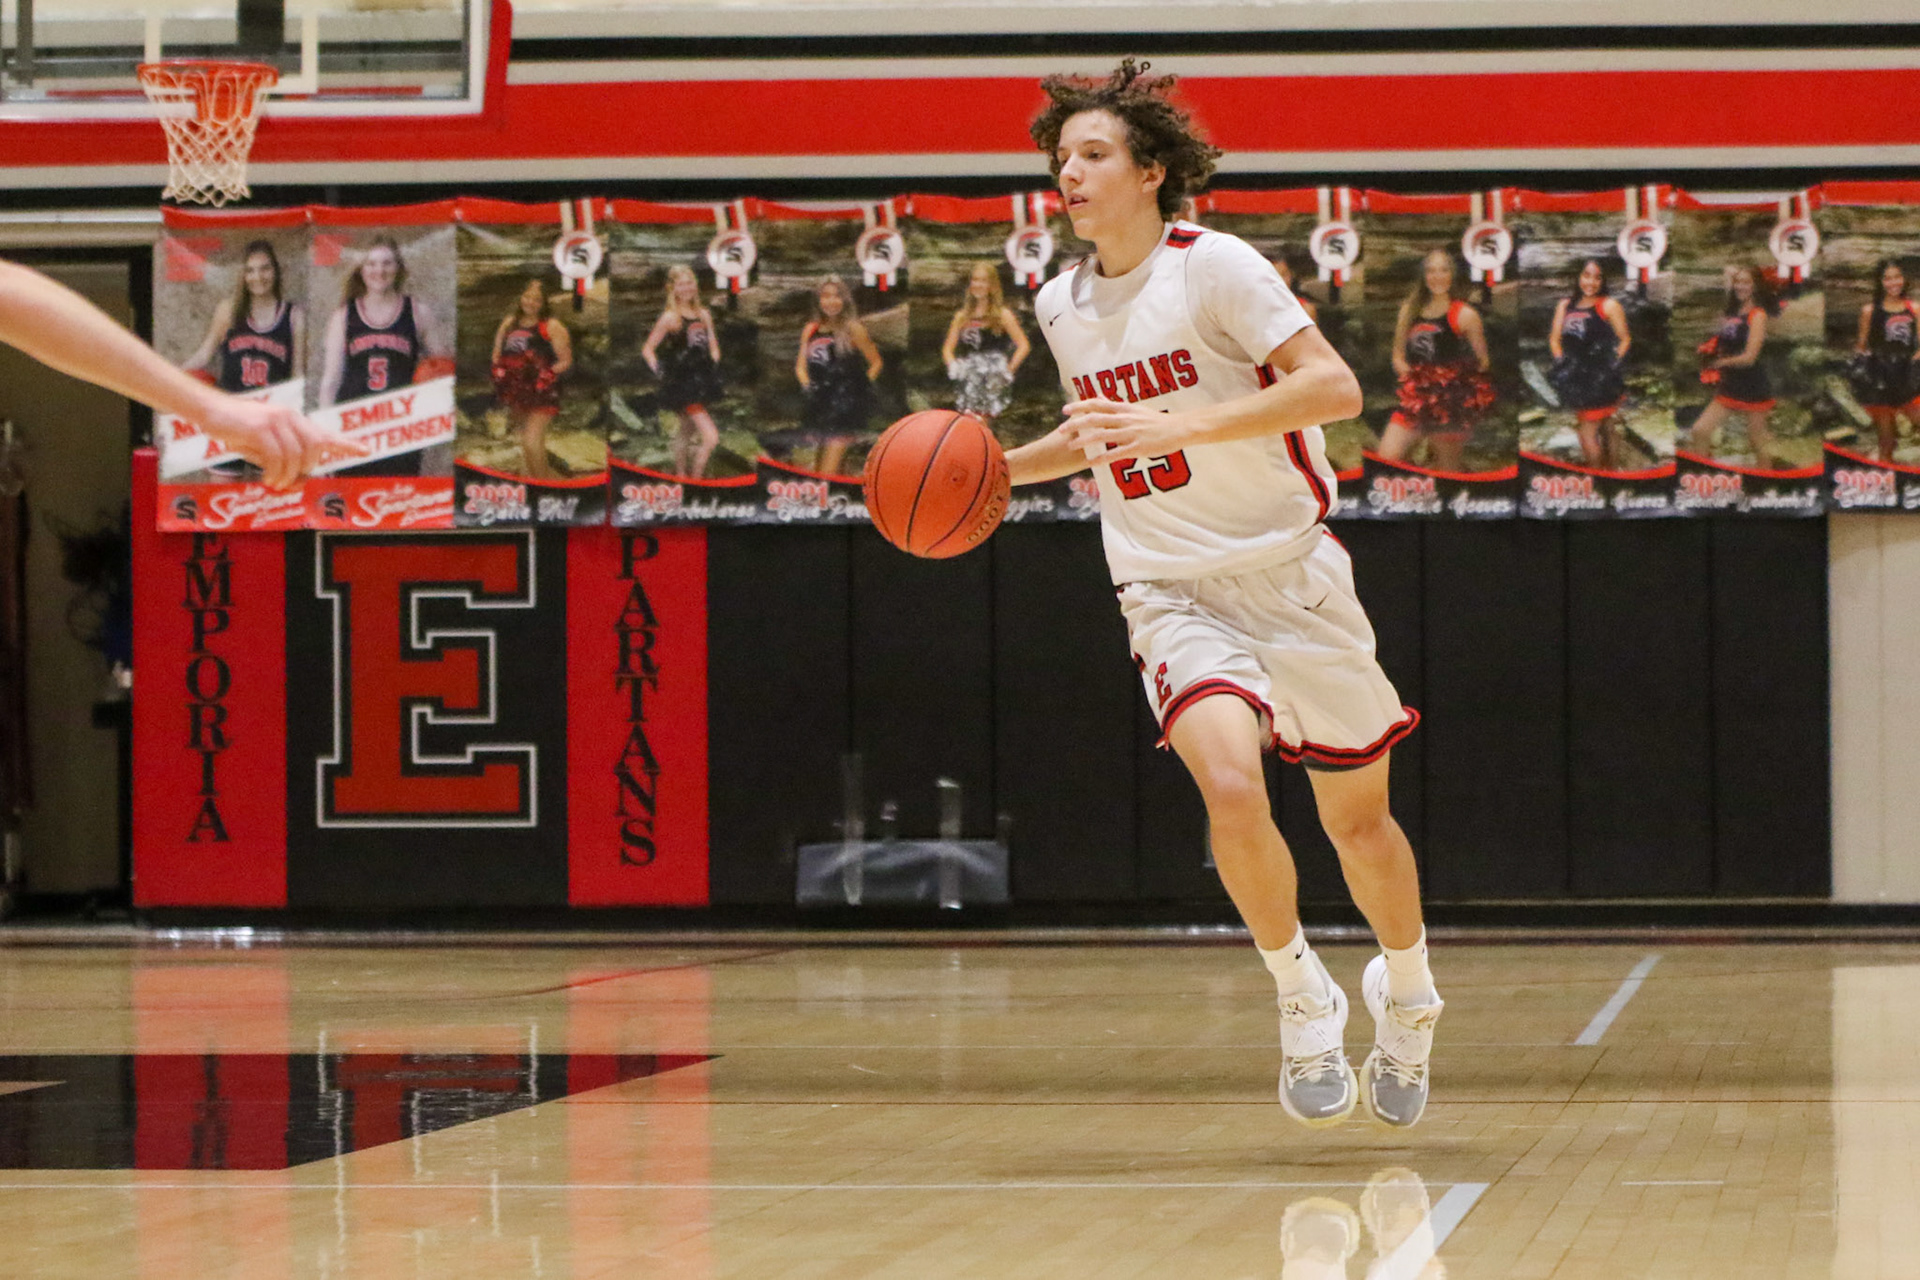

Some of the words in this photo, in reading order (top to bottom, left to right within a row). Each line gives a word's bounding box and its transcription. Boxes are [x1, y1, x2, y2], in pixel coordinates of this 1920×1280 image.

[368, 357, 388, 391] 5
[1072, 349, 1199, 403] PARTANS
[340, 394, 416, 432] EMILY
[181, 531, 235, 842] EMPORIA
[316, 529, 537, 828] E
[612, 527, 662, 867] PARTANS
[1154, 661, 1172, 711] E
